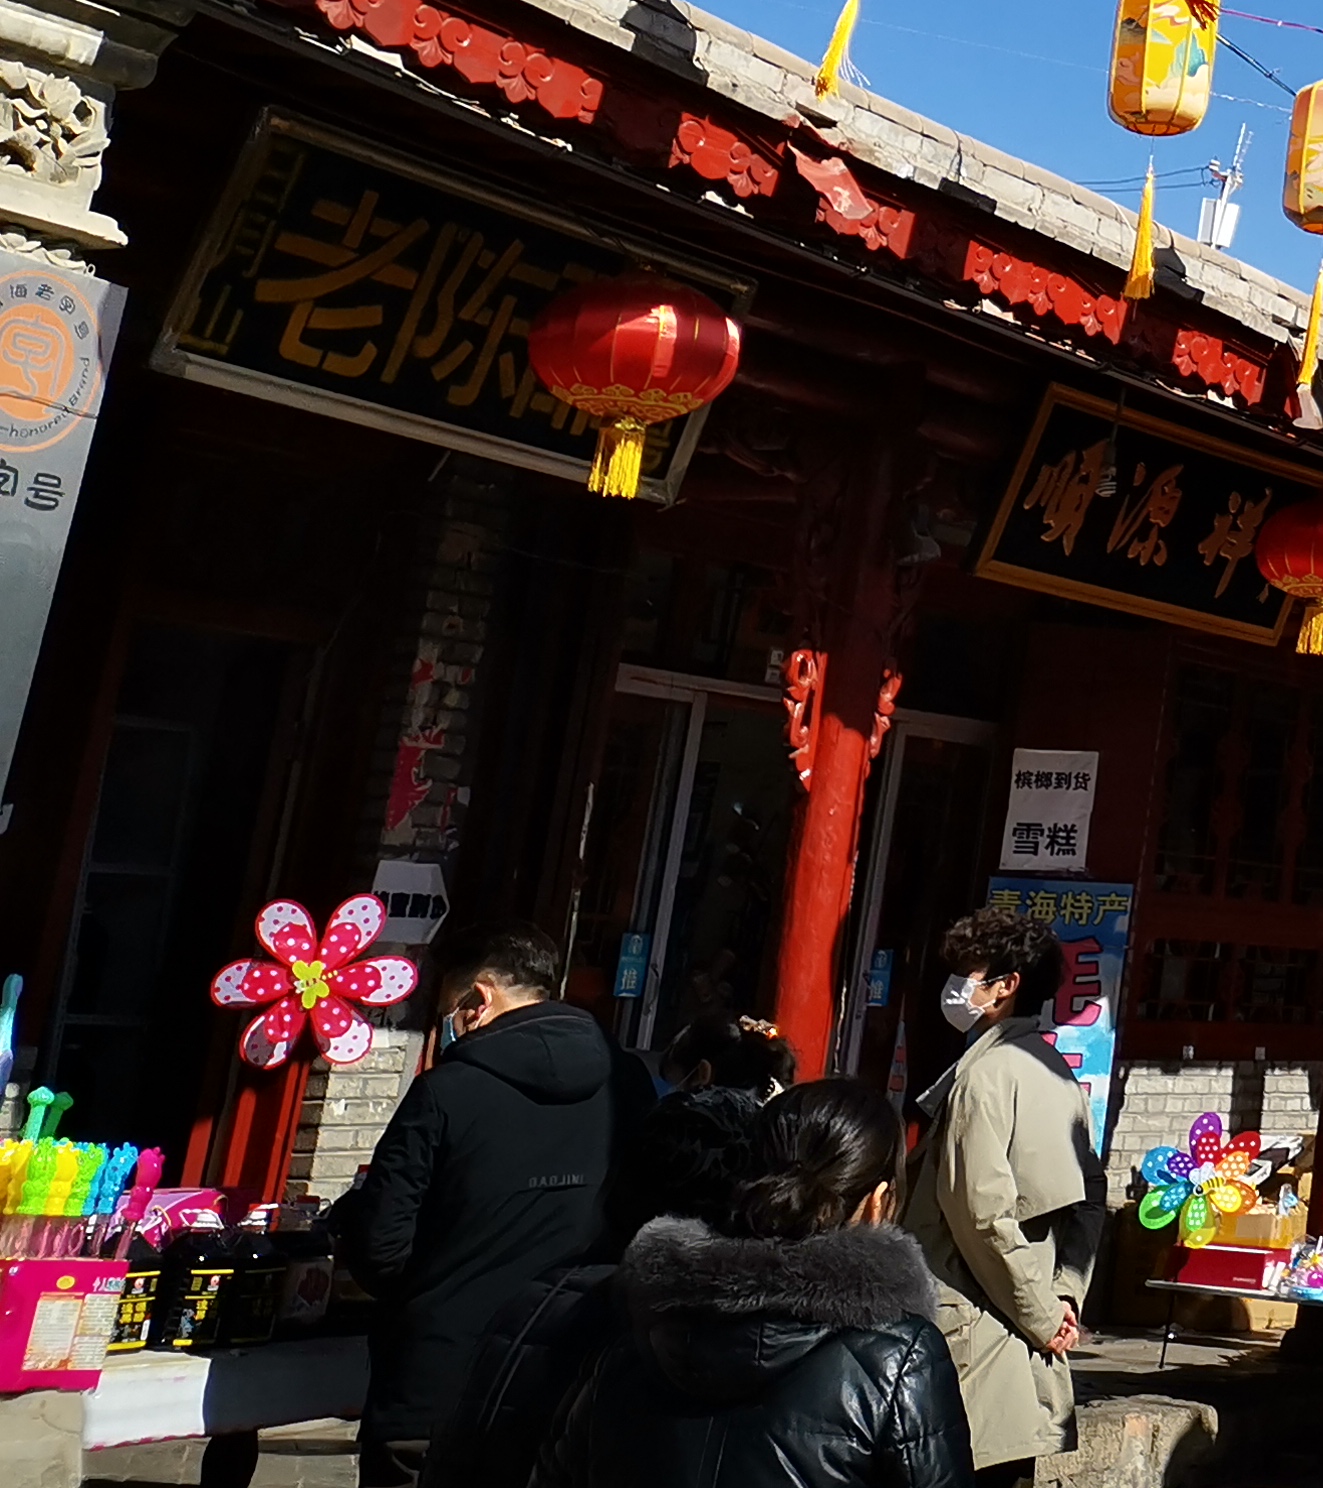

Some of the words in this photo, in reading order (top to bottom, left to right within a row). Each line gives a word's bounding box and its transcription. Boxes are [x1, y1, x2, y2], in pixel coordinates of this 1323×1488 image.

[1014, 770, 1091, 792] 槟榔到货
[1012, 822, 1078, 857] 雪糕
